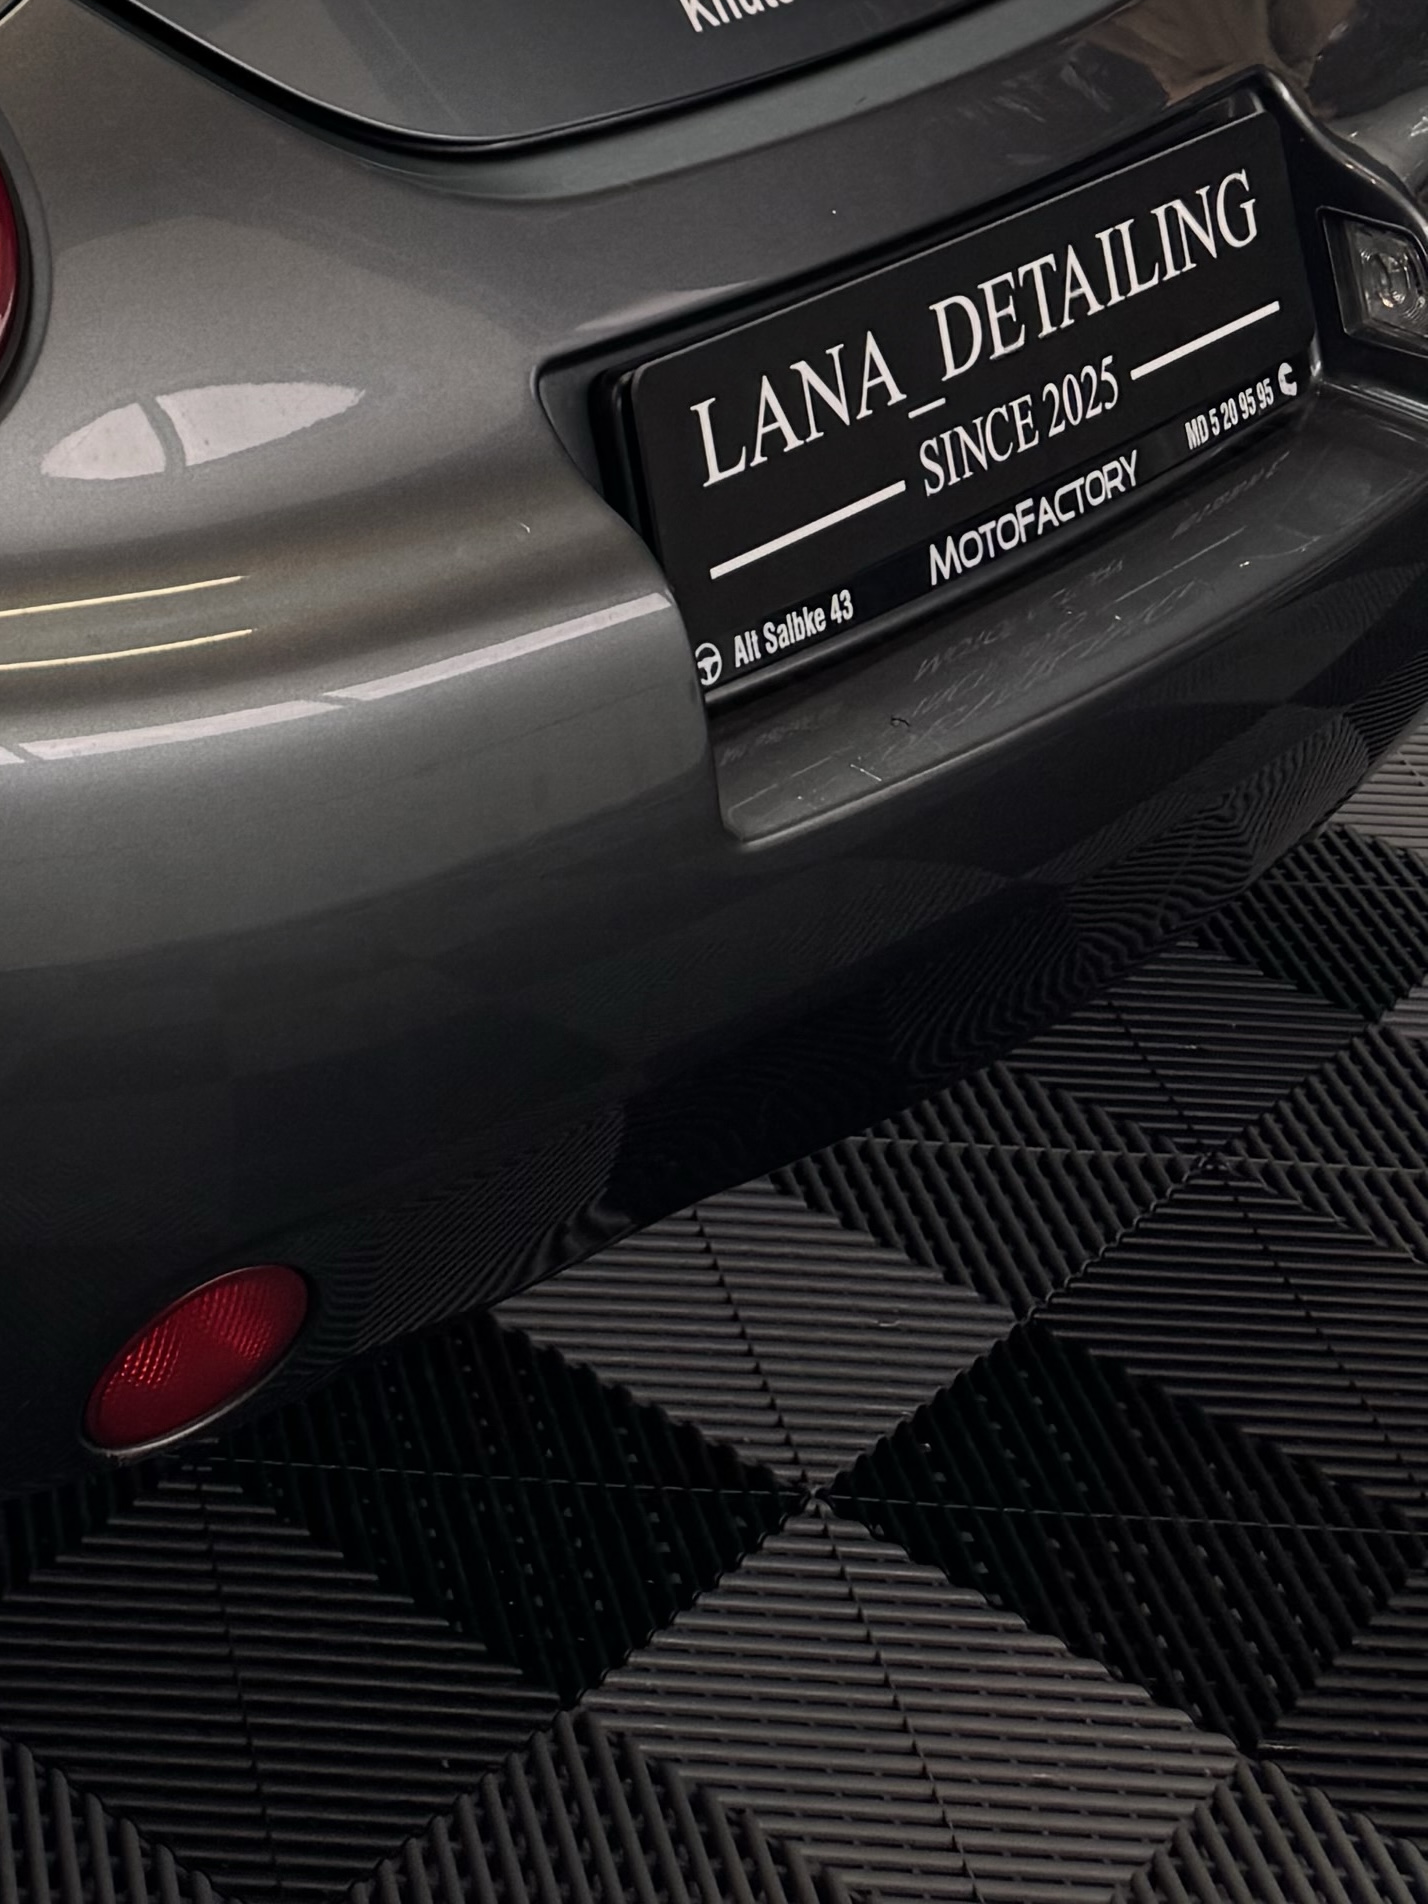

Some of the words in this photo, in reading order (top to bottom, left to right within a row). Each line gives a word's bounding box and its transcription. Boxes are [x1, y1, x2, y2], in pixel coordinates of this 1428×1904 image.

[919, 394, 1040, 497] SINCE
[1042, 355, 1120, 438] 2025
[1184, 413, 1210, 450] MD
[1209, 408, 1221, 436] 5
[1220, 397, 1239, 431] 20
[1238, 387, 1257, 420] 95
[1256, 377, 1275, 410] 95
[734, 629, 762, 668] Alt
[762, 606, 827, 655] Salbke
[830, 589, 854, 624] 43
